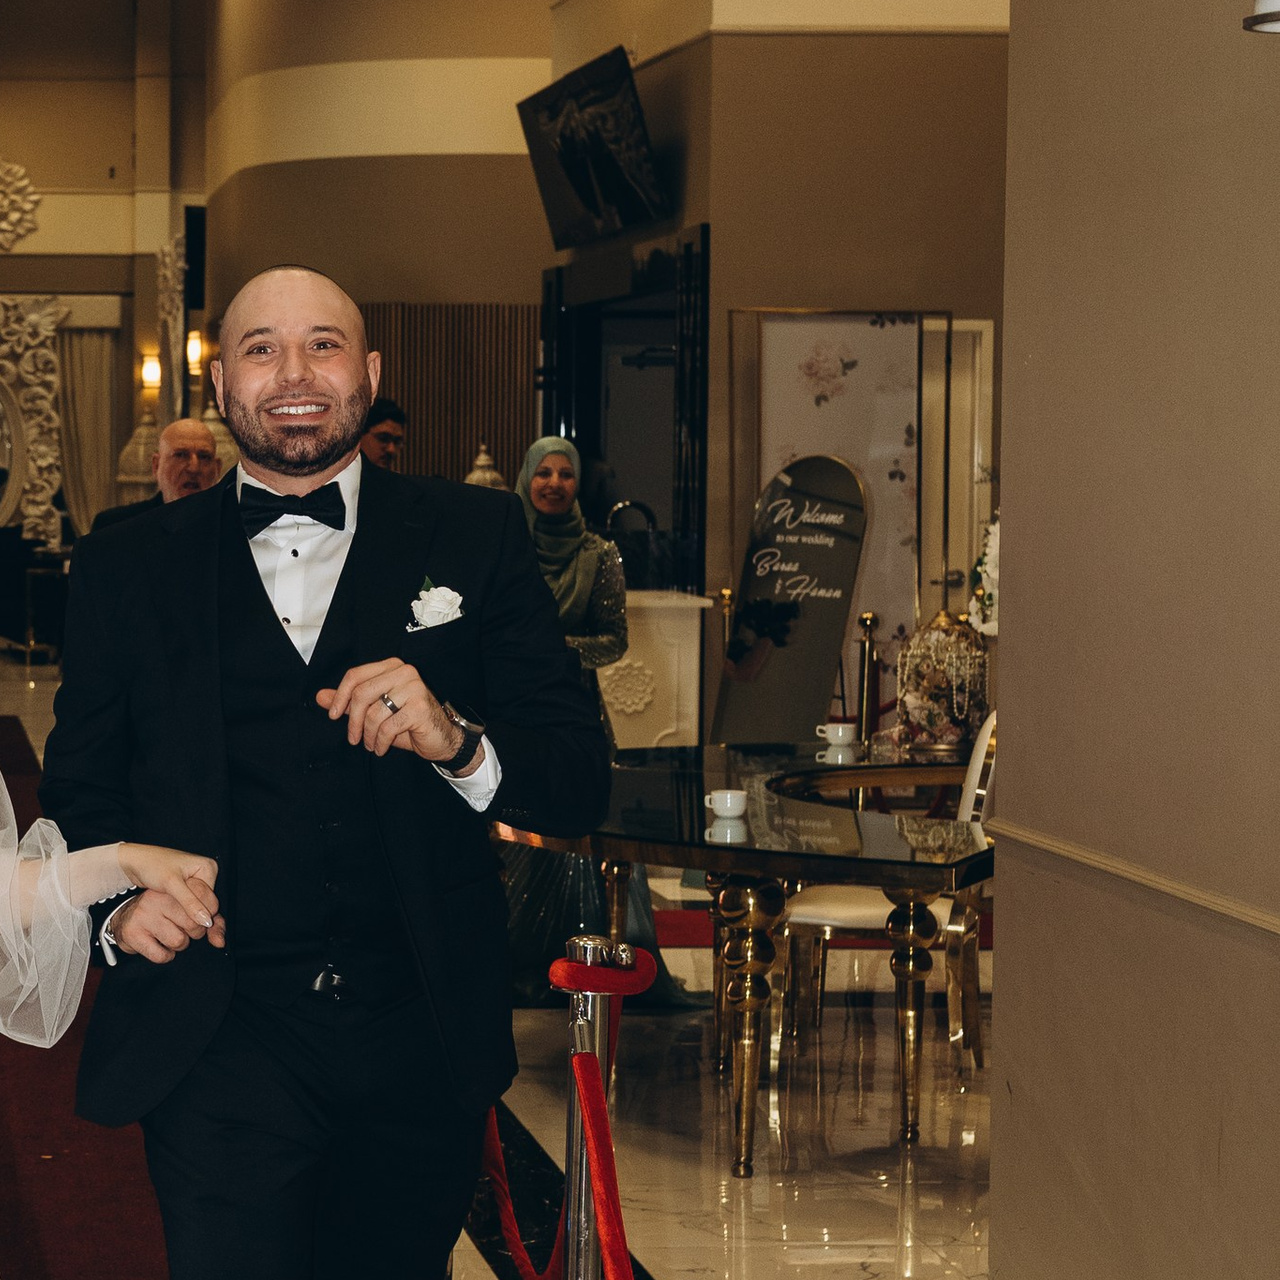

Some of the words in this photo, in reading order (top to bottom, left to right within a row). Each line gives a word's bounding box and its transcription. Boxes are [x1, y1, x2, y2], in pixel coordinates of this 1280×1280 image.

[767, 498, 845, 529] Welcome
[776, 534, 785, 543] to
[785, 535, 800, 544] our
[801, 534, 835, 548] wedding
[785, 574, 843, 601] Hanan
